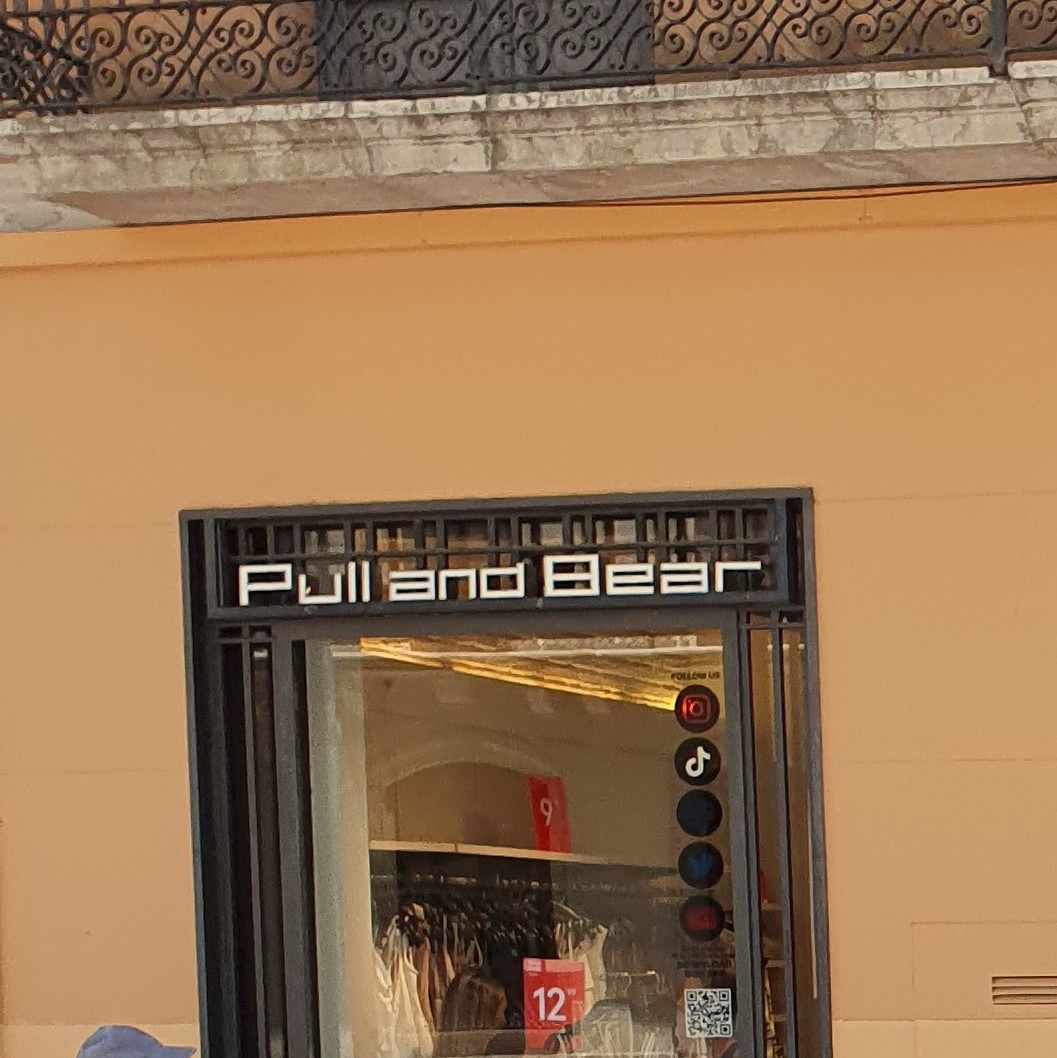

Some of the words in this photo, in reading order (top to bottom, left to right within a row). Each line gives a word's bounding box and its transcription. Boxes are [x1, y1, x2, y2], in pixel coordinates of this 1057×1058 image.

[238, 562, 371, 606] Pull
[388, 563, 526, 601] and
[544, 554, 762, 597] Bear
[671, 671, 707, 680] FOLLOW
[708, 671, 721, 679] US
[540, 797, 553, 827] 9
[532, 986, 567, 1022] 12
